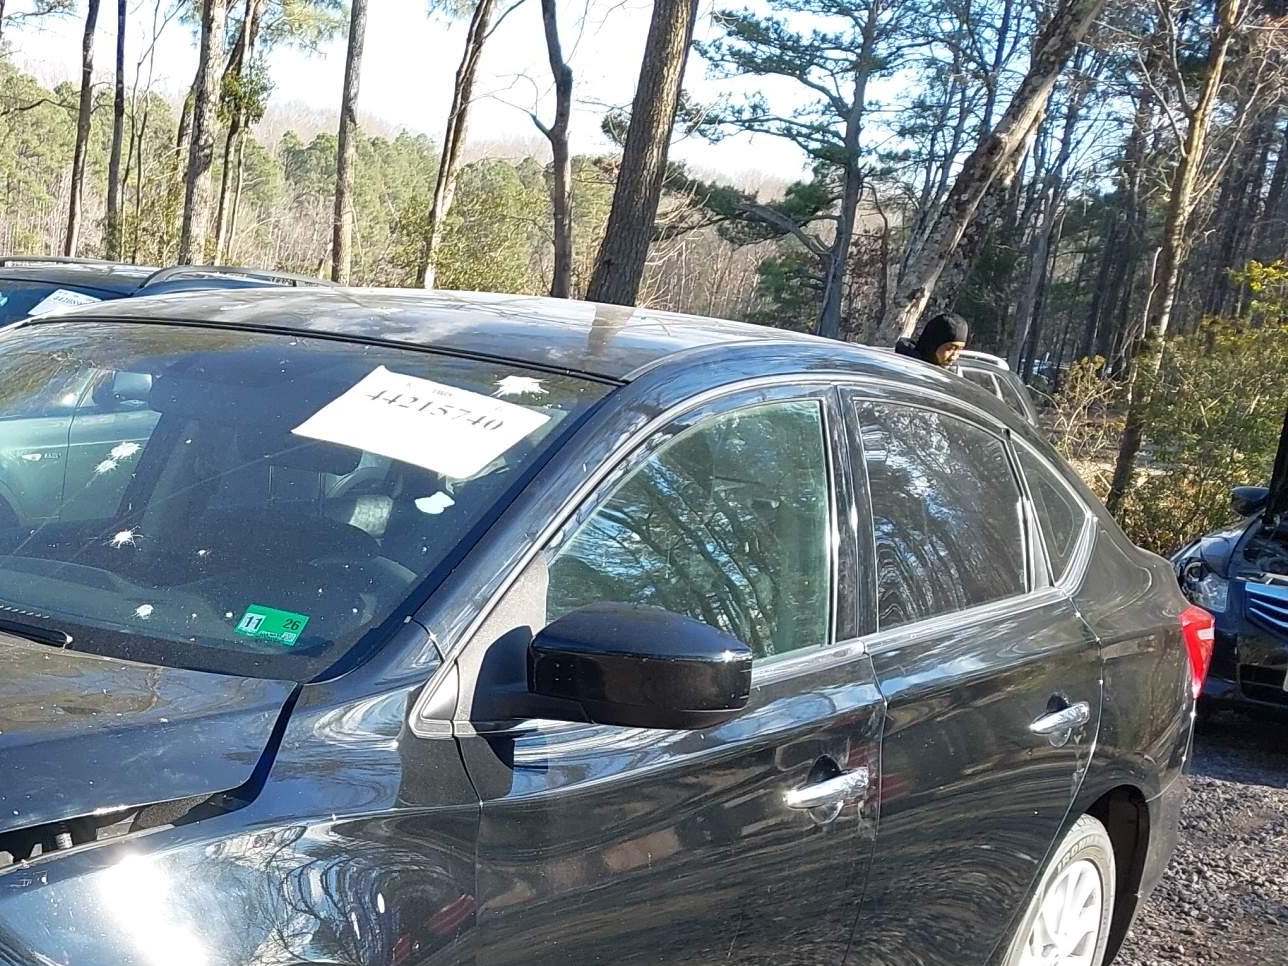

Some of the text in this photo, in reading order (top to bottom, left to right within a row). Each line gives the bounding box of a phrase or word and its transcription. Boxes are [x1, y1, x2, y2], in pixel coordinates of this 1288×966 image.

[365, 389, 504, 431] 44215740
[244, 615, 302, 631] 11 26
